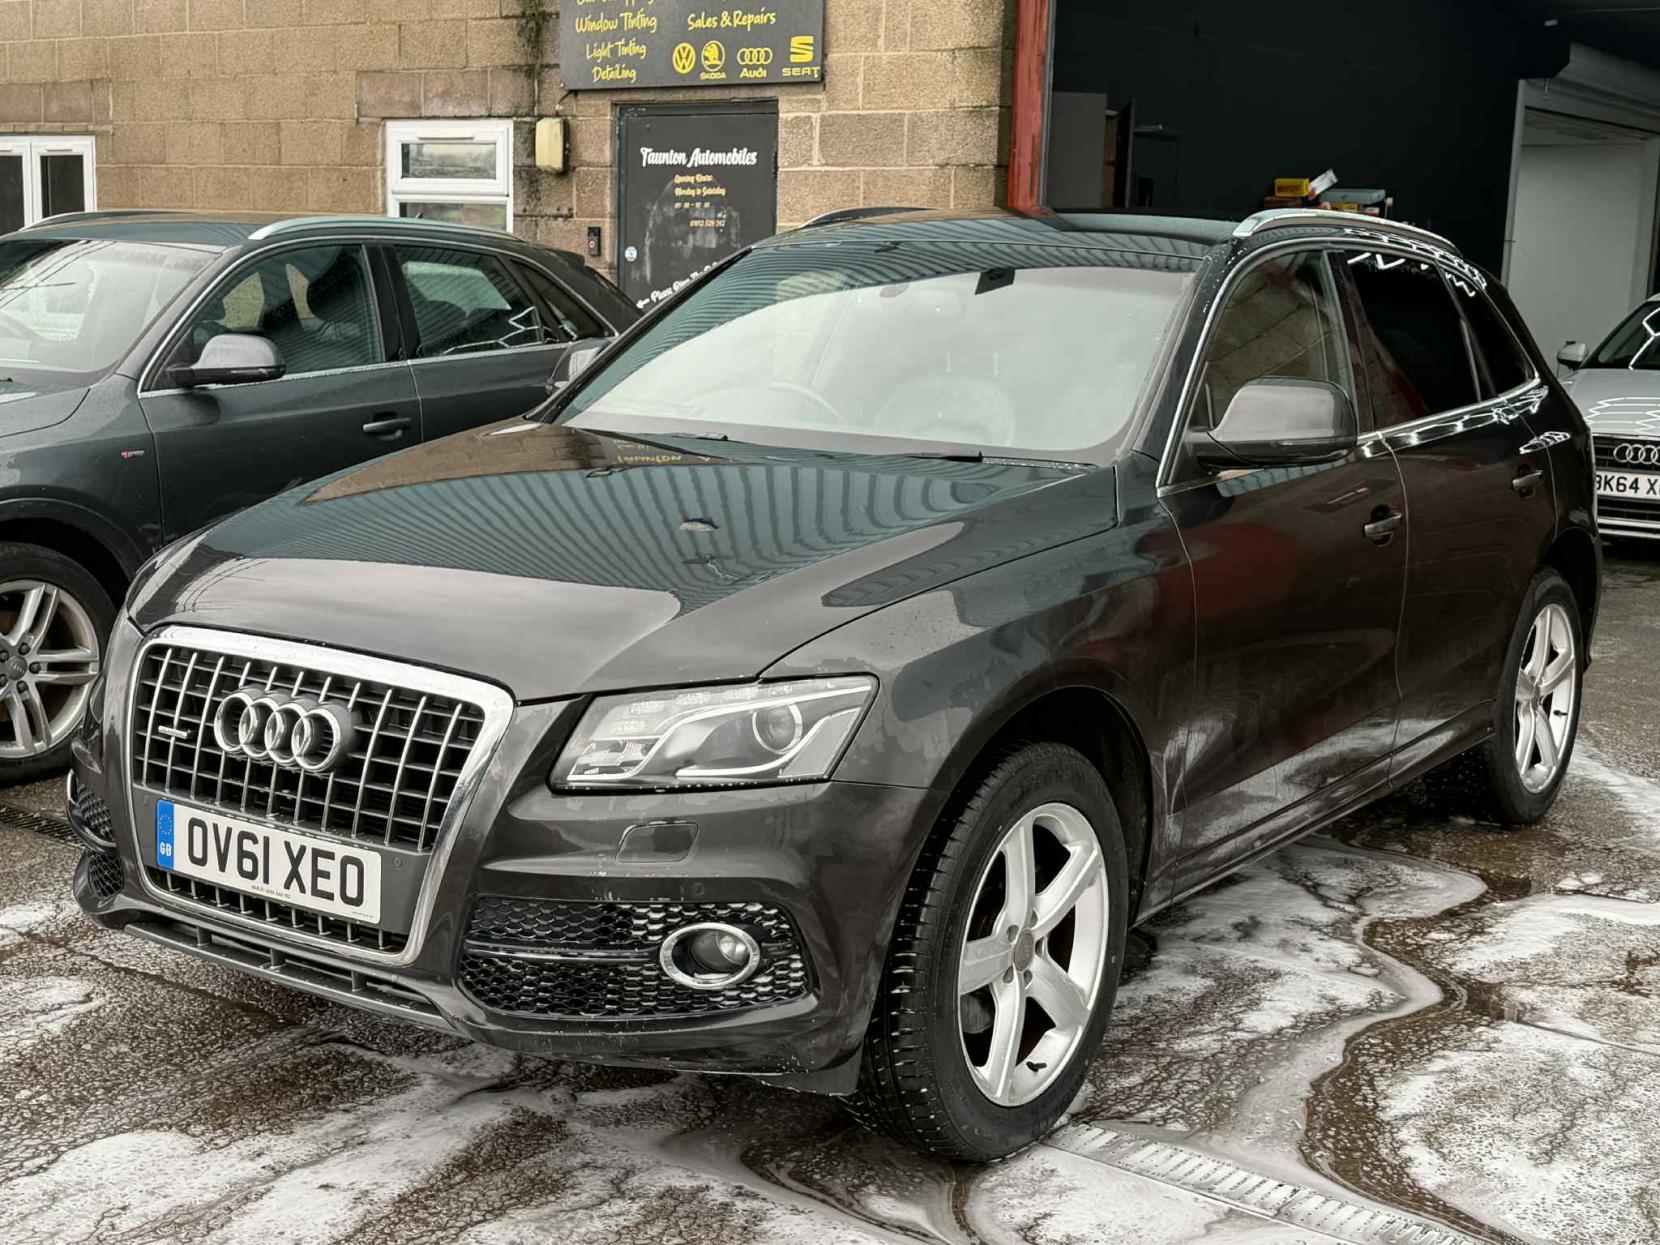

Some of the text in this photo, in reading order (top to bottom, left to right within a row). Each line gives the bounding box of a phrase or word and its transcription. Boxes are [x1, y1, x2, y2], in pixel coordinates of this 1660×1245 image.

[575, 8, 657, 33] Window Tinting
[687, 11, 718, 30] Sales
[733, 7, 776, 31] Repairs
[585, 37, 646, 62] Light Tinting
[592, 63, 636, 83] Detailing
[740, 67, 767, 78] Audi
[782, 66, 820, 77] SEAT
[640, 147, 758, 168] Taunton Automobiles
[1646, 478, 1660, 496] X
[159, 842, 172, 857] GB
[187, 817, 365, 907] OV61 XEO
